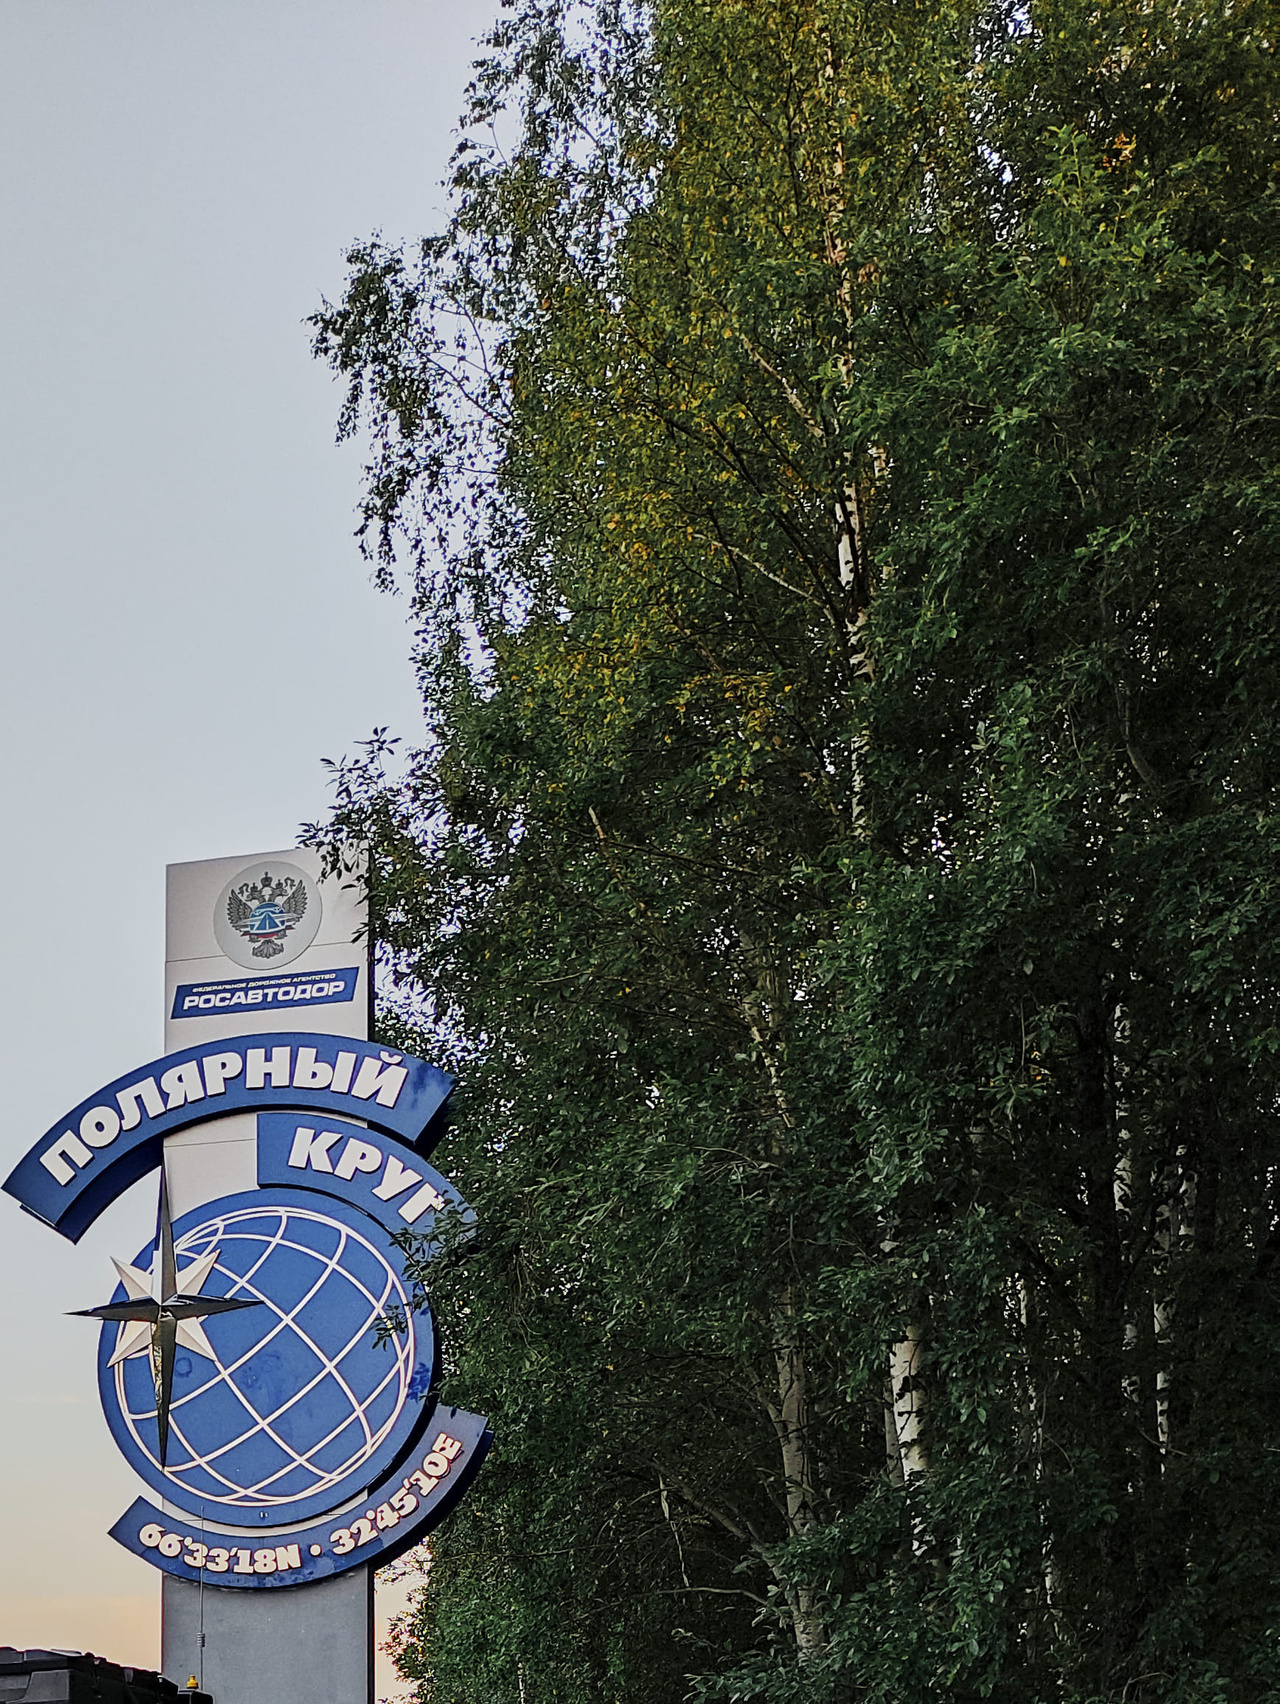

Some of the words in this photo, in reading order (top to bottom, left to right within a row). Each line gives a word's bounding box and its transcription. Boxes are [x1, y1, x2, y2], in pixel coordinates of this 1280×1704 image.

[182, 980, 346, 1010] РОСАВТОДОР
[38, 1045, 409, 1188] ПОЛЯРНЫЙ
[287, 1126, 447, 1226] КРУГ
